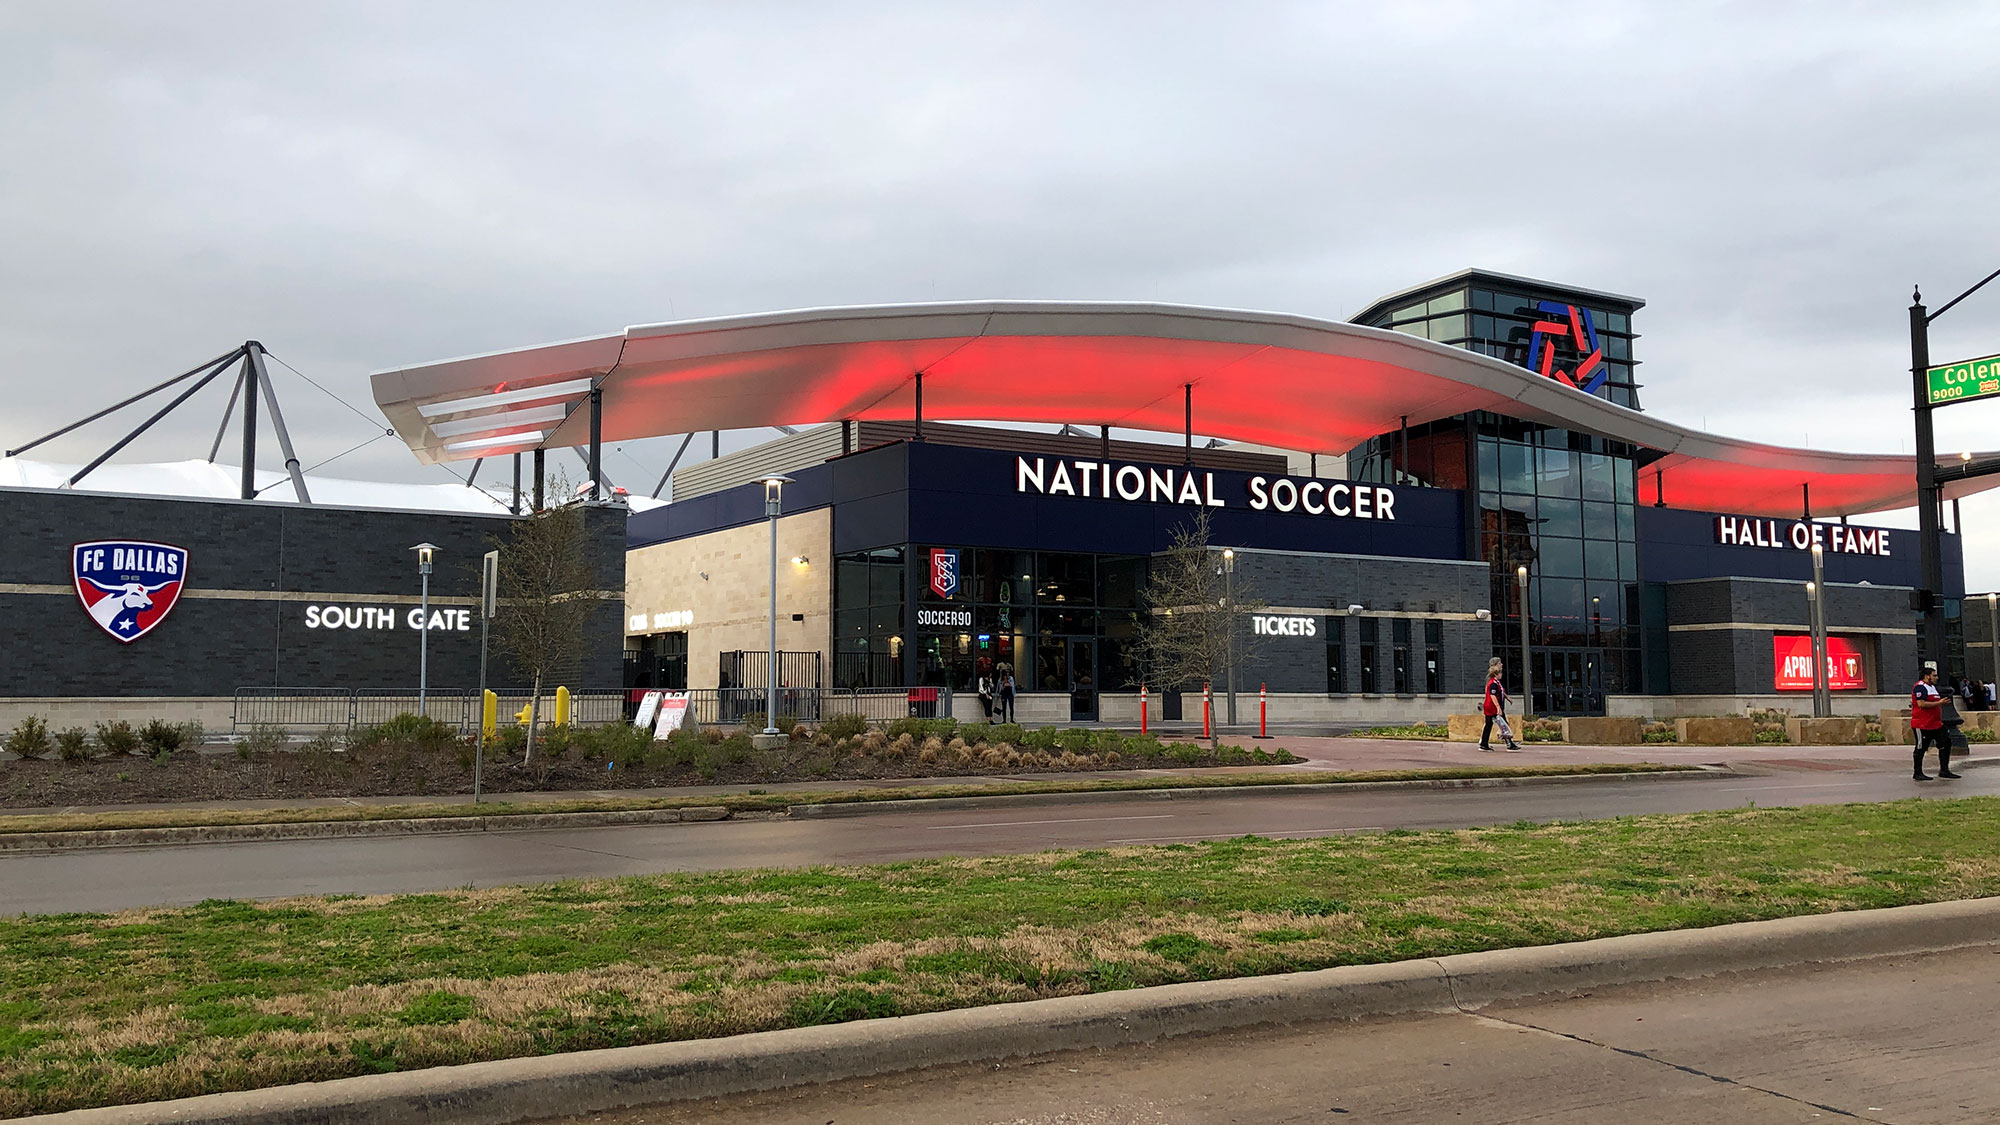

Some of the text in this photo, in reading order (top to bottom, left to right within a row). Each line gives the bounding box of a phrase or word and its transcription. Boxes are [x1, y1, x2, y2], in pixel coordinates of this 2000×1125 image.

[1933, 386, 1963, 400] 9000
[1018, 456, 1396, 520] NATIONAL SOCCER
[1720, 516, 1891, 556] HALL OF FAME
[82, 548, 178, 575] FC DALLAS
[305, 605, 470, 631] SOUTH GATE
[917, 610, 971, 626] SOCCER90
[1253, 615, 1316, 637] TICKETS
